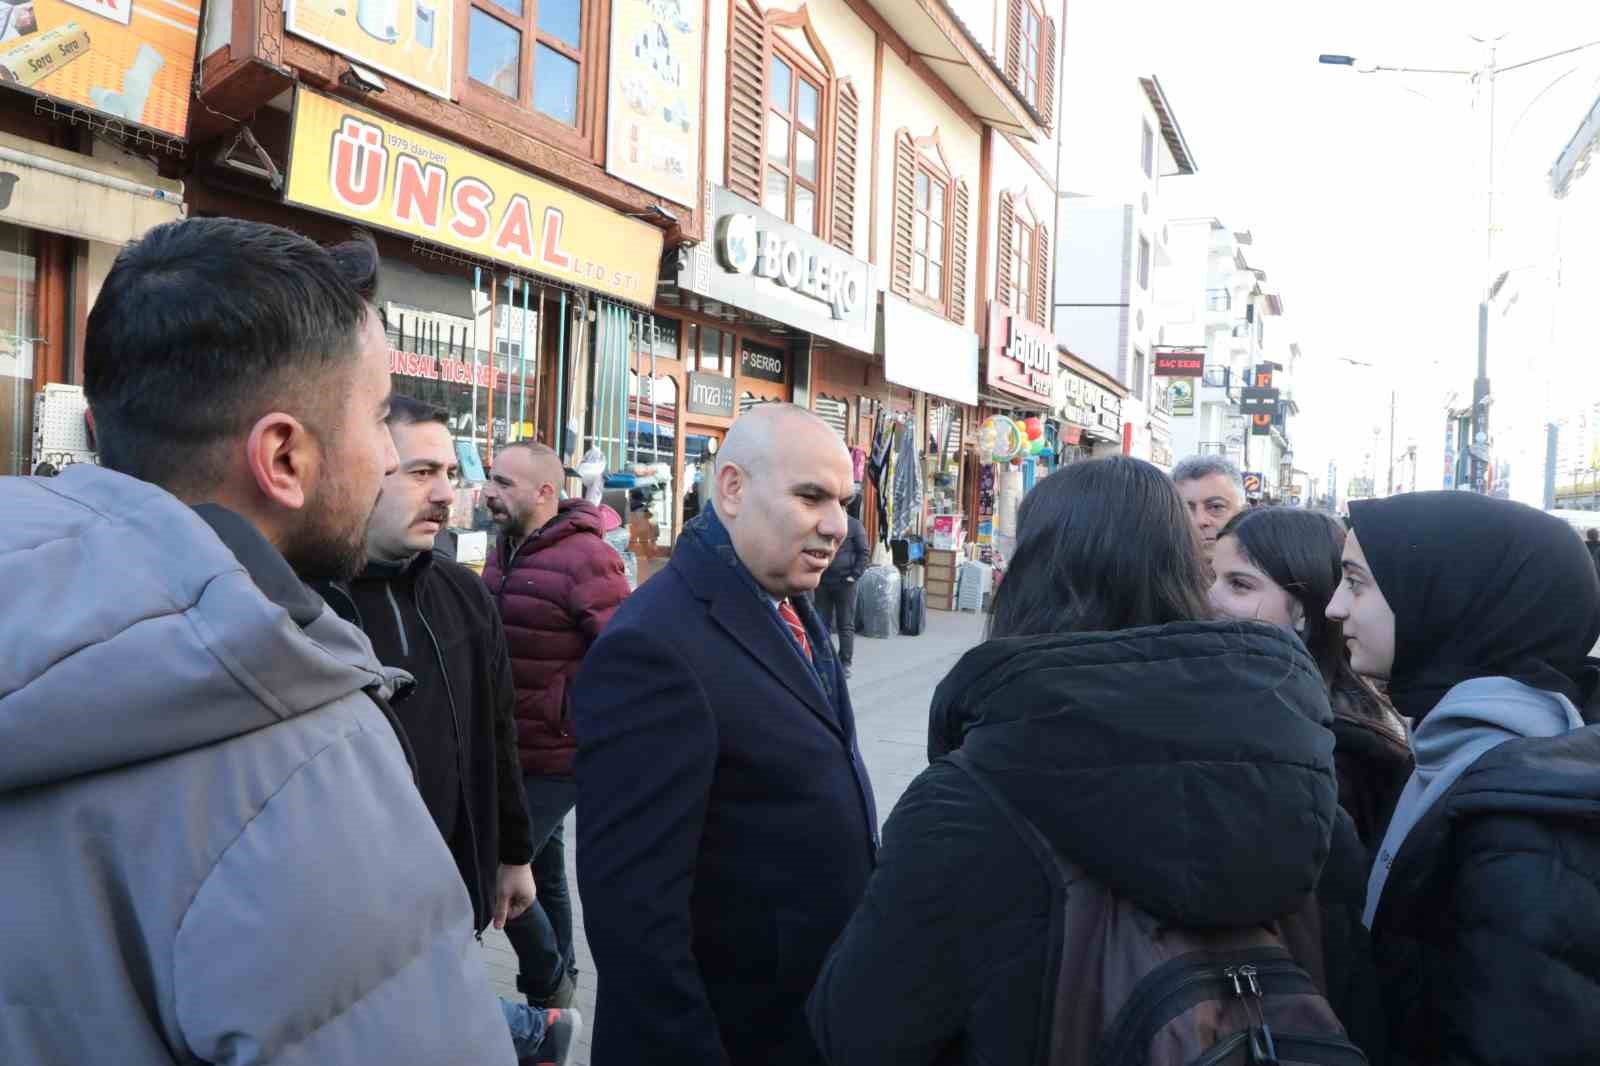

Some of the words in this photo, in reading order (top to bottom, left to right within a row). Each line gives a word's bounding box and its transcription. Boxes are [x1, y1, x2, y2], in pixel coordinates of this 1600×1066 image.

[331, 117, 571, 269] ÜNSAL
[756, 229, 863, 321] BOLERO
[1004, 316, 1055, 376] Japon
